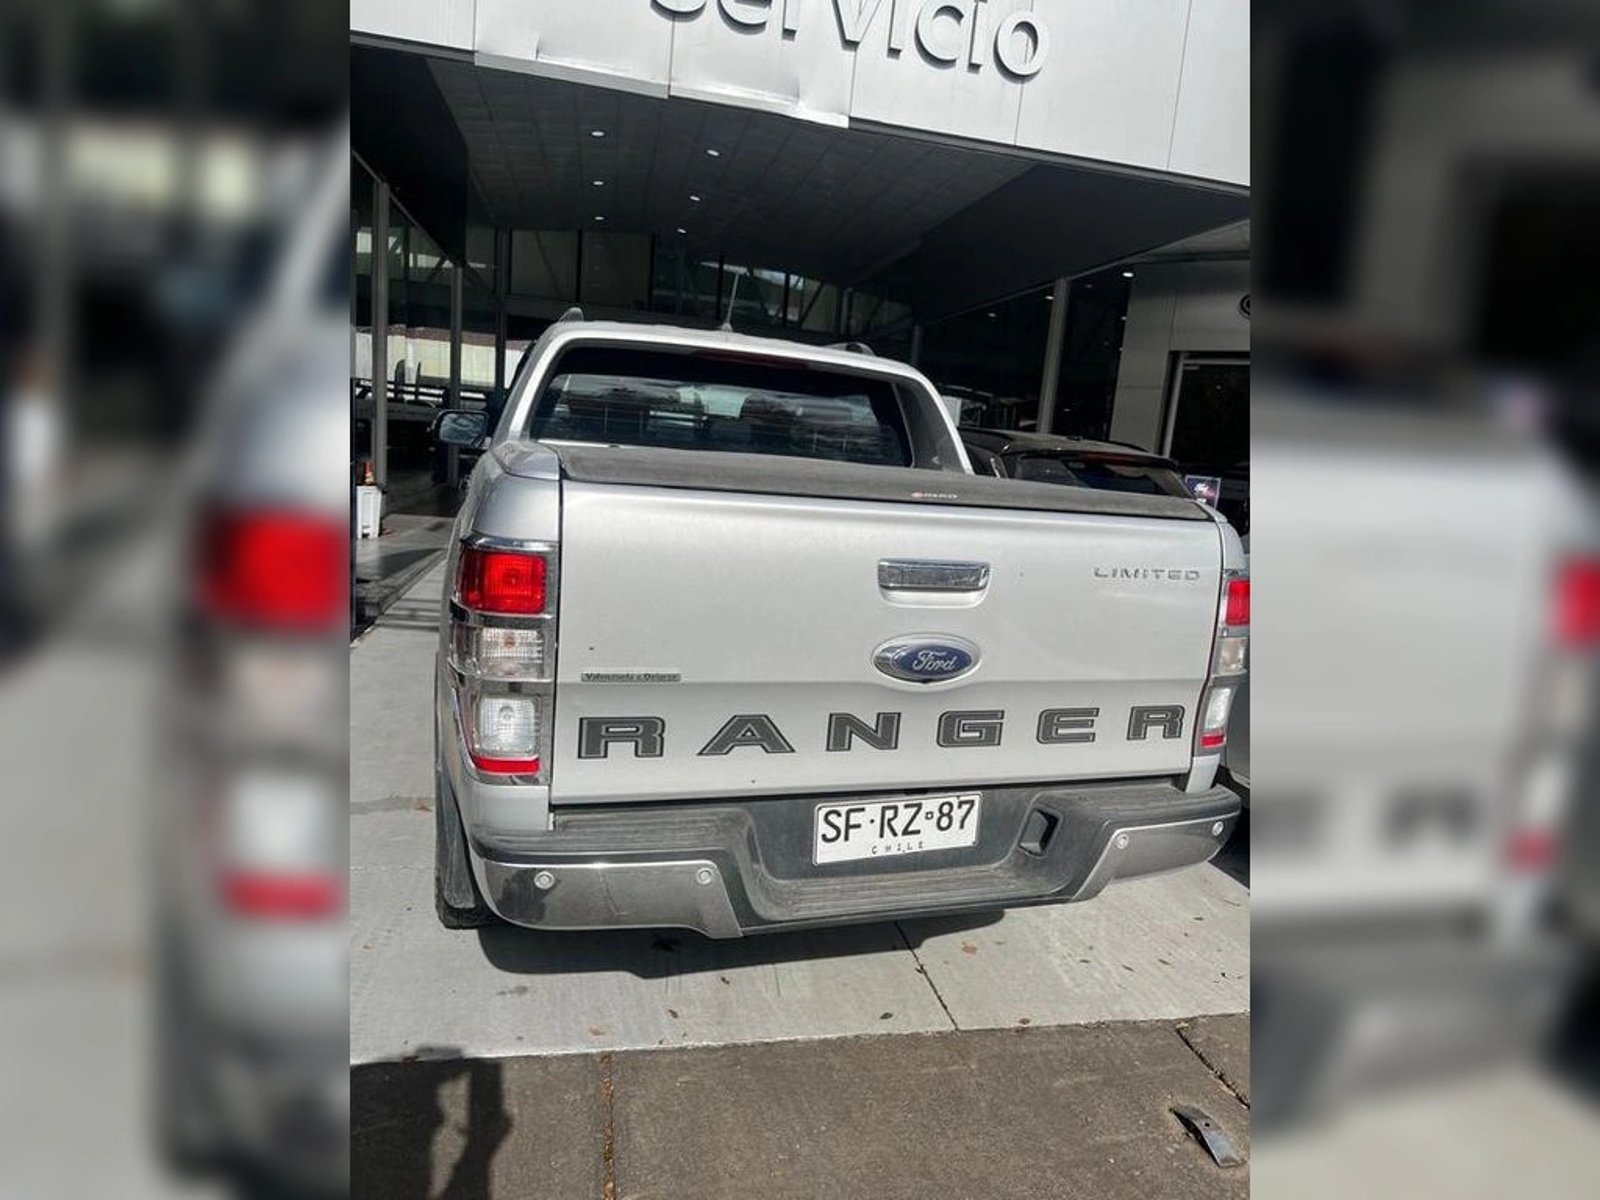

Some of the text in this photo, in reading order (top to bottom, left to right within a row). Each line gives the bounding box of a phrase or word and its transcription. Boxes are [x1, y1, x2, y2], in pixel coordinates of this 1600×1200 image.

[648, 0, 1050, 83] vicio
[1093, 566, 1201, 581] LIMITED
[911, 649, 958, 671] Ford
[577, 705, 1185, 759] RANGER
